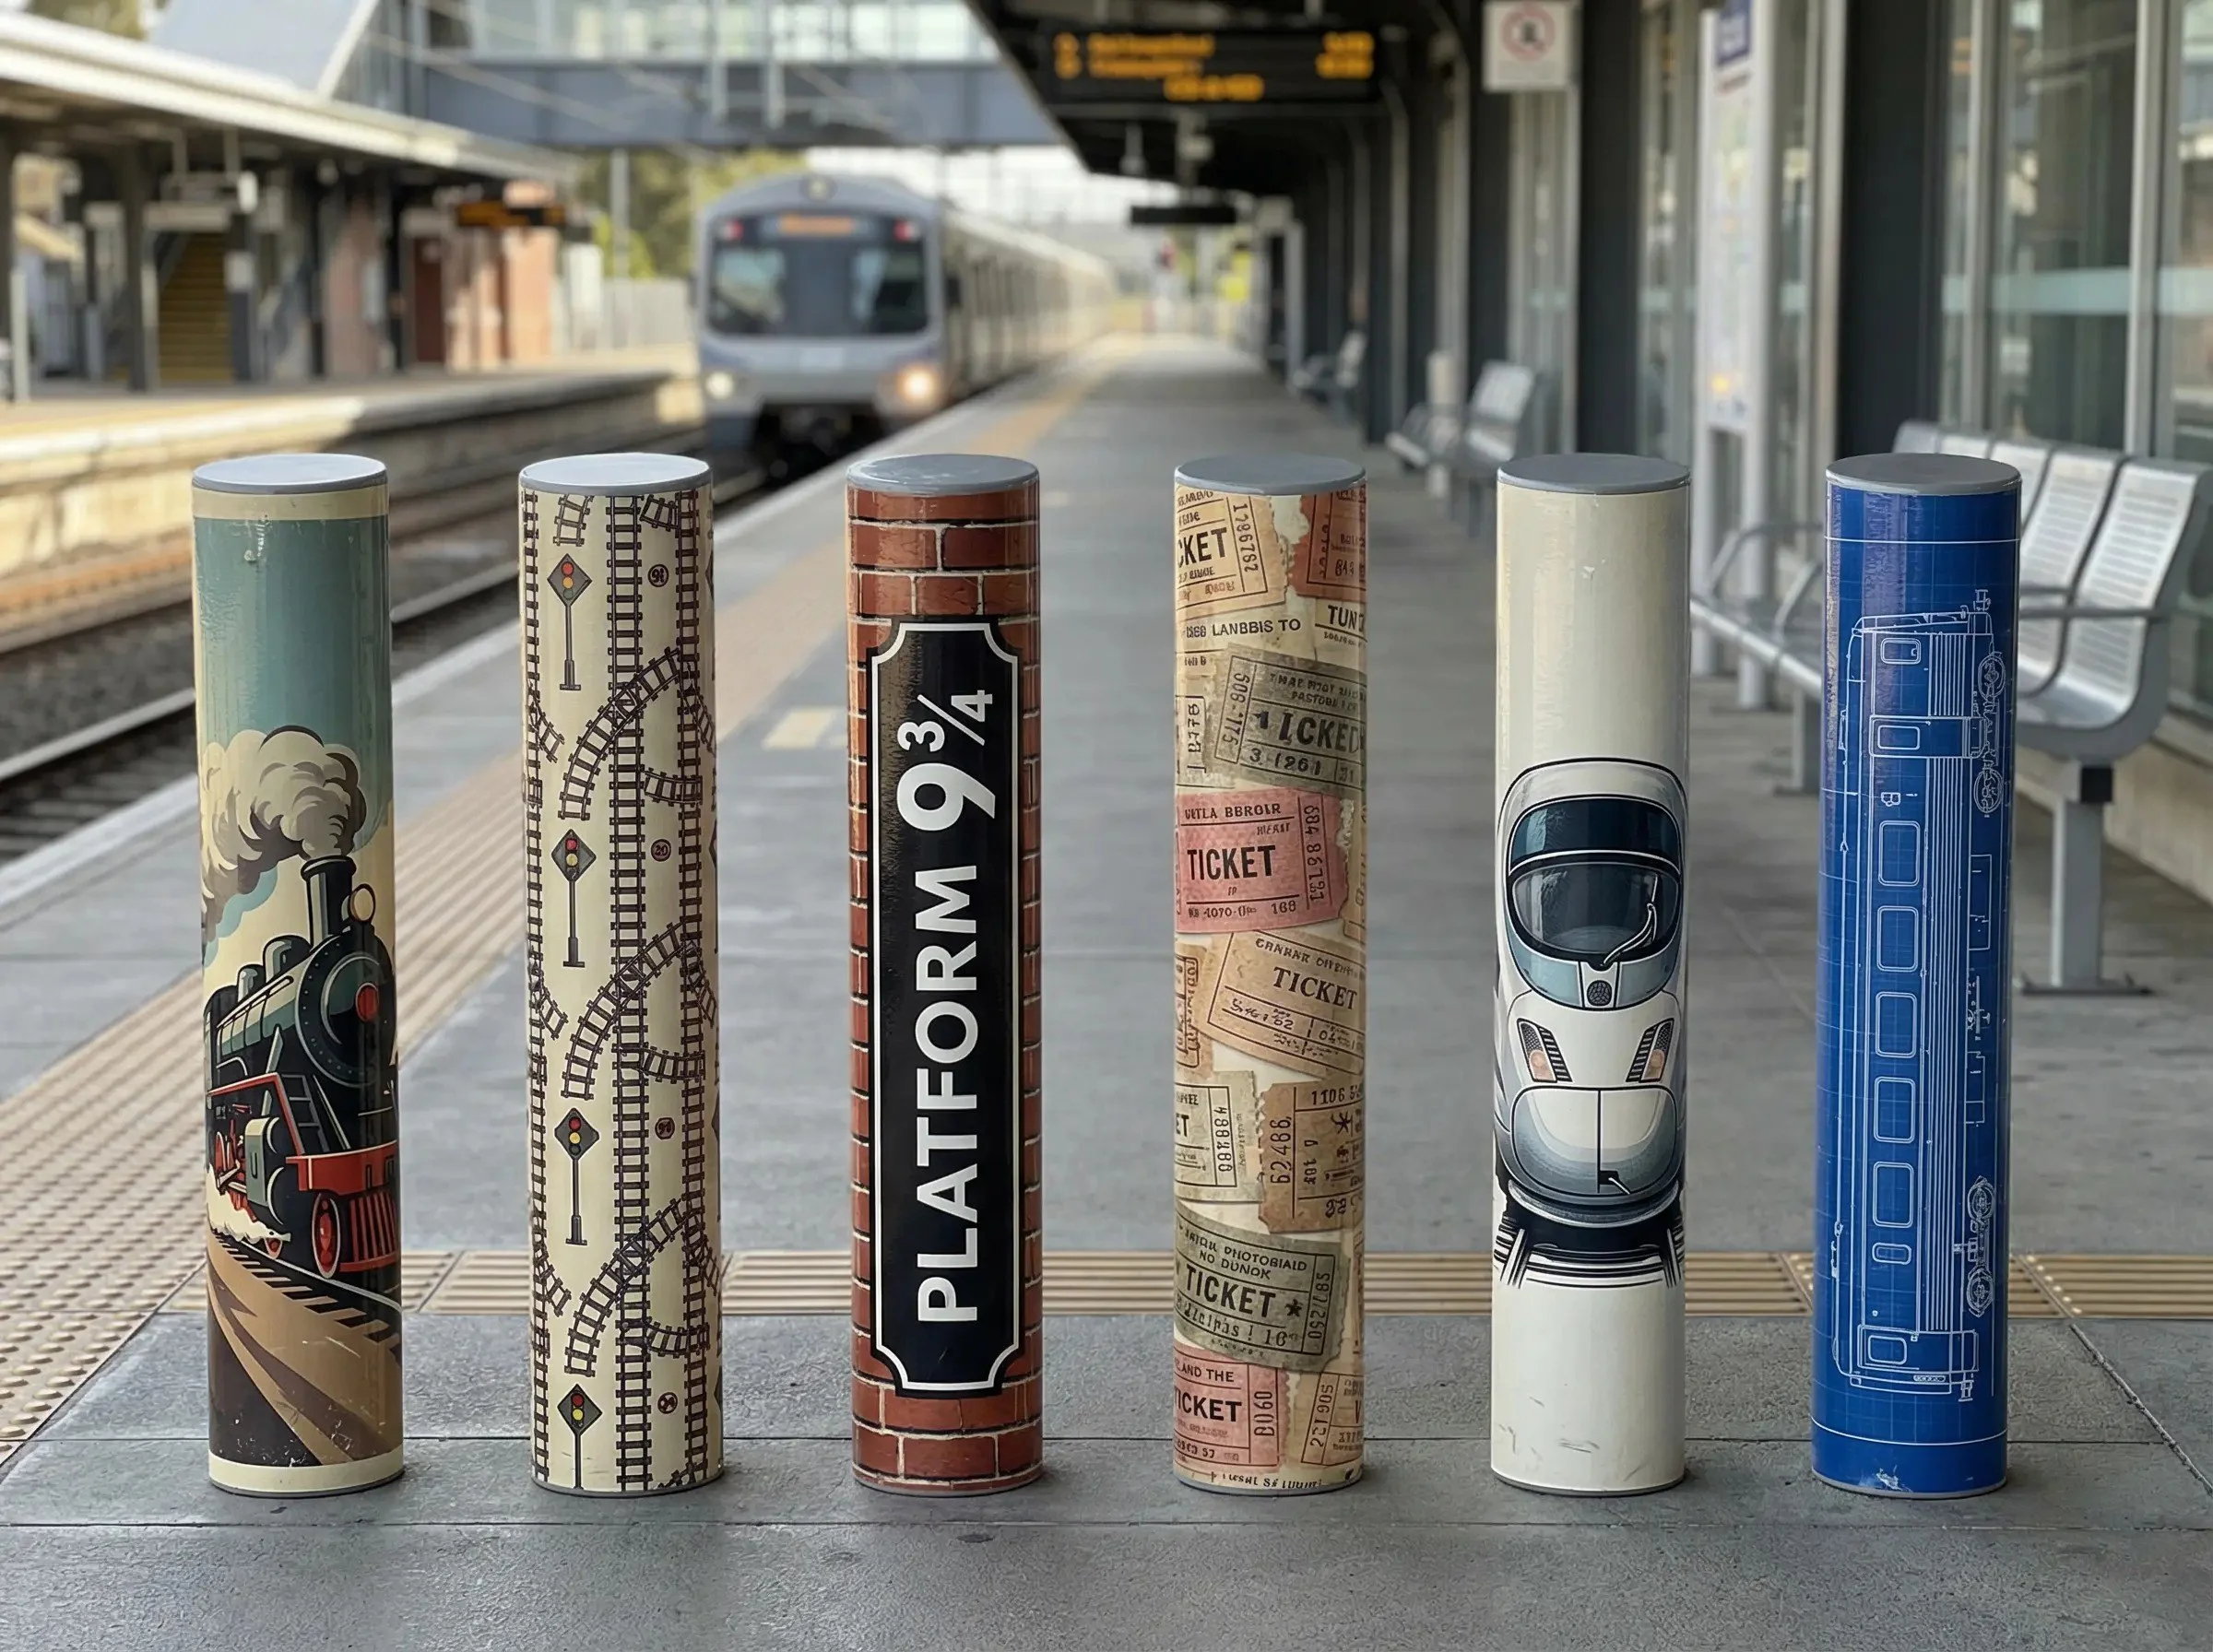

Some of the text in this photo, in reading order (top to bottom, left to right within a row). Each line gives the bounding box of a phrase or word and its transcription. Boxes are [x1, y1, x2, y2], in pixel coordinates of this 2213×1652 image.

[1278, 618, 1301, 631] TO
[1187, 844, 1276, 881] TICKET
[1273, 966, 1358, 1011] TICKET
[915, 865, 979, 1322] PLATFORM
[1199, 1251, 1215, 1264] NO
[1186, 1263, 1277, 1318] TICKET
[1206, 1368, 1235, 1383] THE
